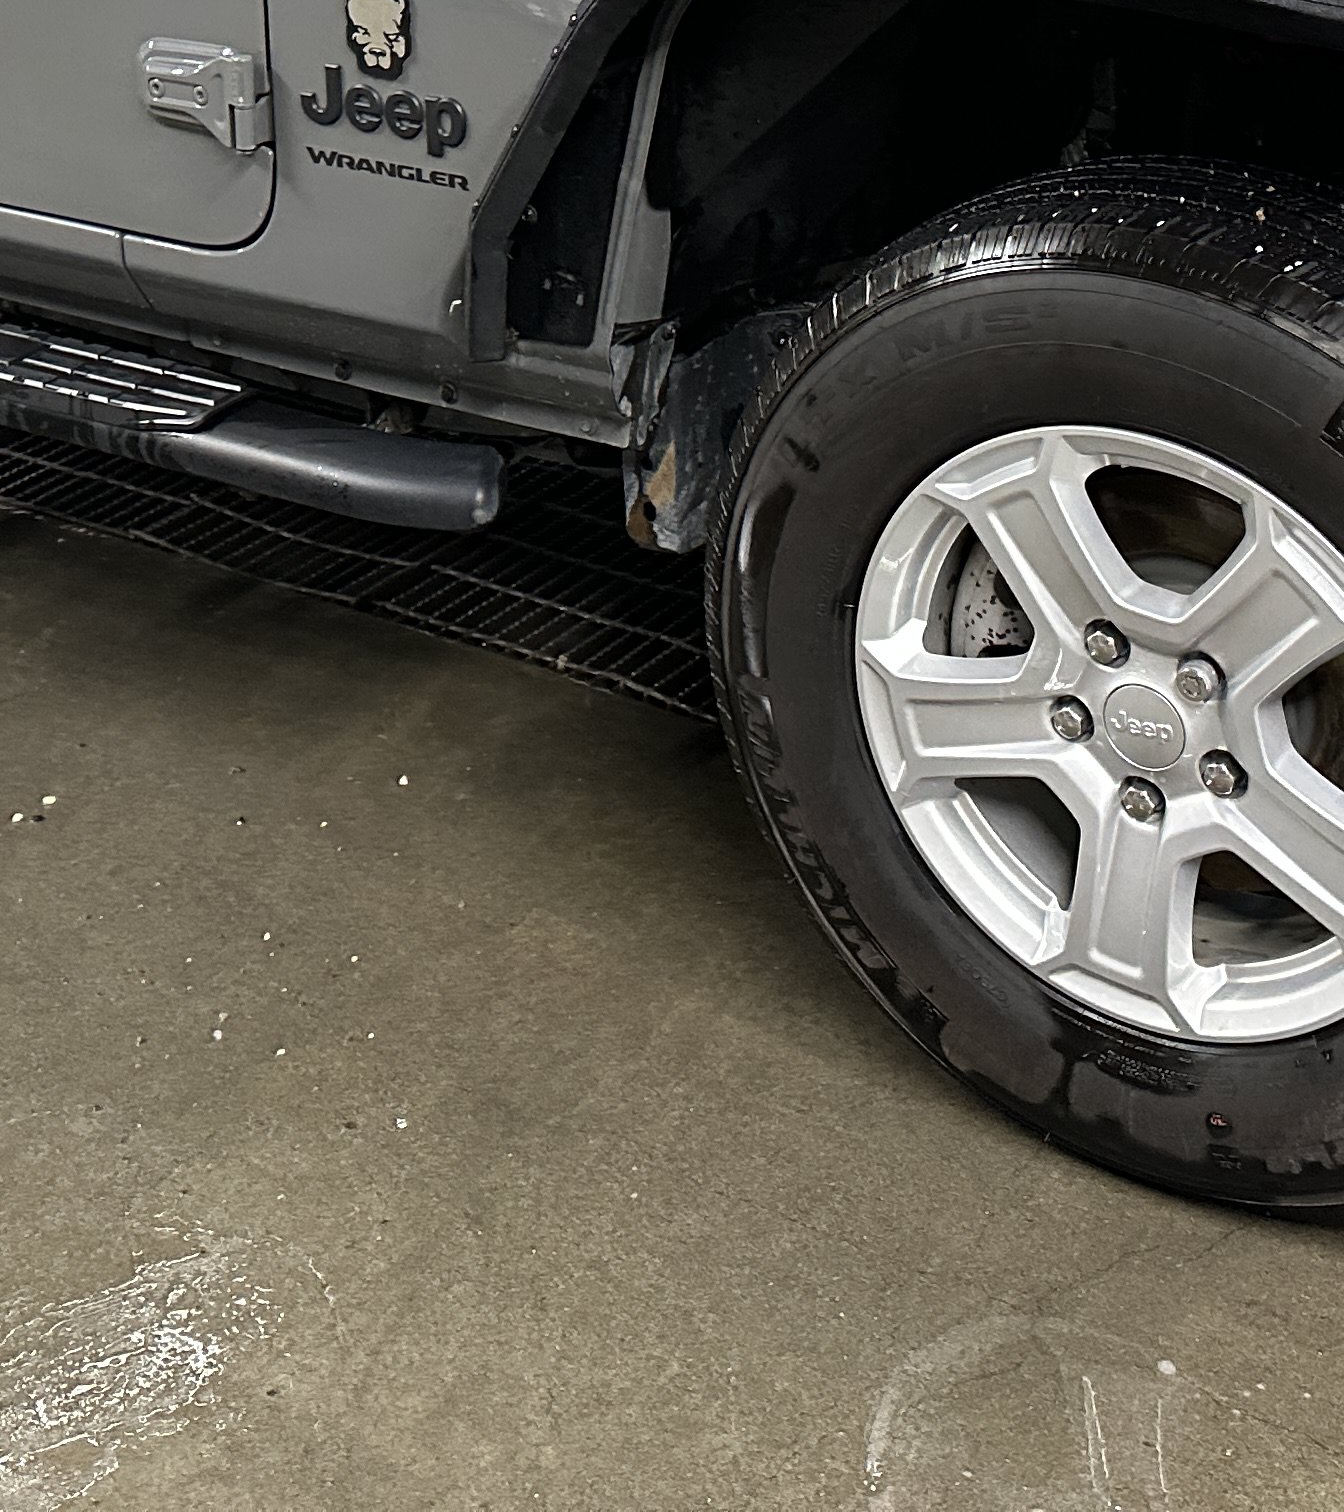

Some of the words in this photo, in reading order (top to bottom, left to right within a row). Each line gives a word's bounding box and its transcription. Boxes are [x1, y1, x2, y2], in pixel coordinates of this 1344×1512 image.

[300, 63, 468, 158] Jeep
[306, 146, 470, 192] WRANGLER
[1110, 710, 1174, 745] Jeep
